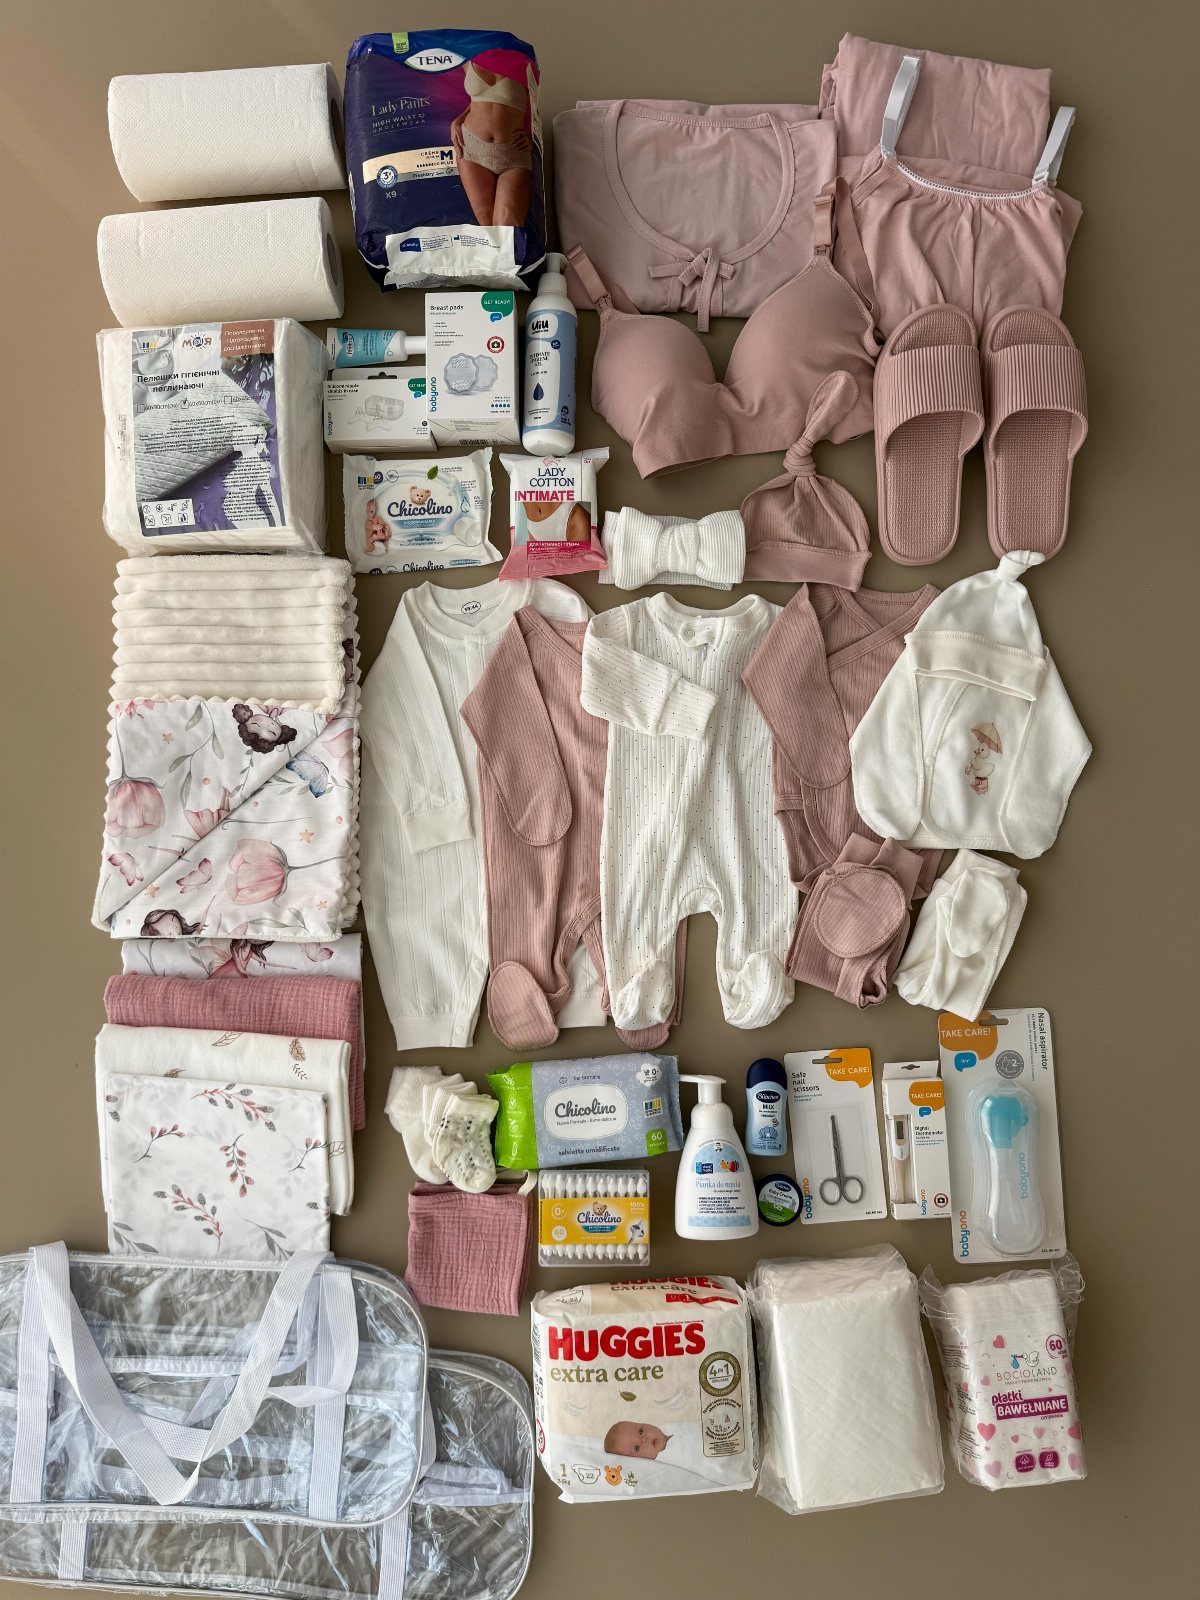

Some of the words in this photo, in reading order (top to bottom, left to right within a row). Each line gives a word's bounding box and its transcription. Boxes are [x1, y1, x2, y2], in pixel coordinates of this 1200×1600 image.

[416, 55, 452, 66] TENA
[371, 101, 398, 117] Lady
[400, 96, 431, 111] Pants
[372, 119, 391, 128] HIGH
[393, 113, 416, 123] WAIST
[440, 150, 453, 160] M
[450, 304, 464, 312] pads
[137, 371, 180, 384] Пелюшки
[152, 382, 205, 394] поглинаючі
[429, 377, 437, 413] babyono
[538, 467, 566, 477] LADY
[529, 477, 575, 487] COTTON
[514, 490, 575, 502] INTIMATE
[387, 498, 453, 518] Chicolino
[1038, 1012, 1046, 1034] Nasal
[941, 1029, 963, 1038] TAKE
[964, 1027, 991, 1037] CARE!
[1038, 1034, 1048, 1071] aspirator
[829, 1068, 847, 1076] TAKE
[848, 1066, 870, 1074] CARE!
[792, 1078, 806, 1086] nail
[793, 1085, 820, 1093] scissors
[554, 1097, 617, 1118] Chicolino
[651, 1131, 663, 1141] 60
[558, 1147, 584, 1156] salviette
[585, 1145, 620, 1154] umidificate
[1018, 1152, 1029, 1200] babyono
[803, 1177, 813, 1220] babyono
[577, 1210, 622, 1224] Chicolino
[959, 1210, 971, 1258] babyono
[610, 1284, 657, 1292] extra
[660, 1284, 698, 1295] care
[548, 1323, 706, 1362] HUGGIES
[1049, 1339, 1063, 1351] 60
[550, 1366, 609, 1383] extra
[614, 1364, 664, 1381] care
[996, 1366, 1058, 1382] BOCIOLAND
[997, 1398, 1067, 1417] BAWEŁNIANE
[559, 1463, 567, 1477] 1
